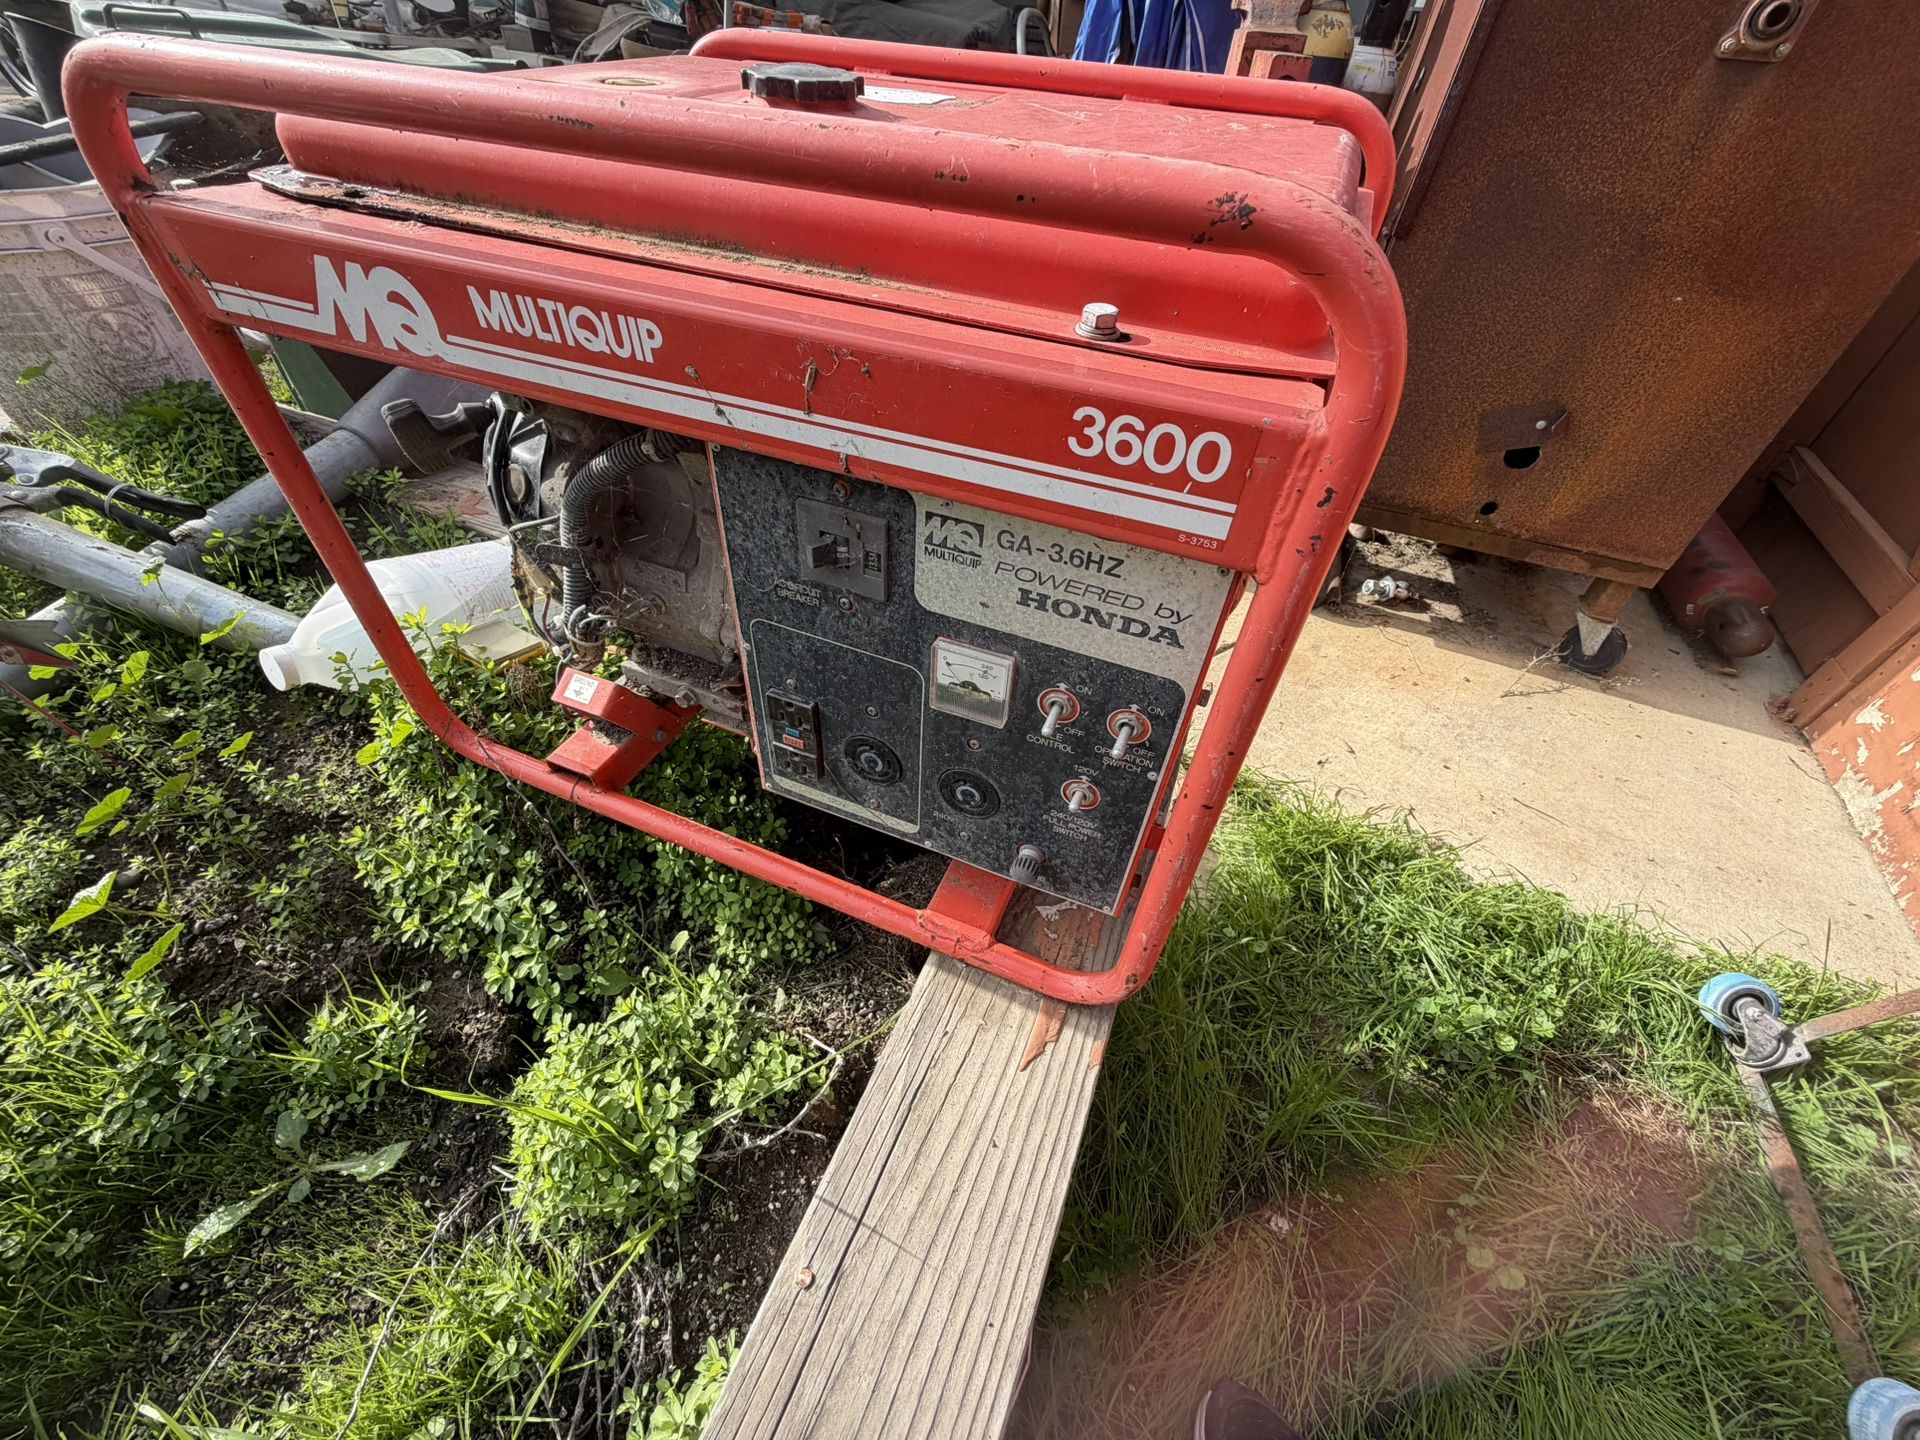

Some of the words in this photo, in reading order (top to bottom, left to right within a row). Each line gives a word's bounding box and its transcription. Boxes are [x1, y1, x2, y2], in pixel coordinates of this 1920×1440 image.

[313, 254, 446, 358] MQ
[467, 285, 662, 363] MULTIQUIP
[1067, 406, 1232, 483] 3600
[1177, 533, 1217, 549] S-3753
[924, 546, 982, 569] MULTIQUIP
[996, 529, 1125, 579] GA-3.6HZ
[778, 588, 820, 608] BREAKER
[994, 562, 1145, 610] POWERED
[1154, 602, 1194, 625] by
[1016, 588, 1185, 649] HONDA
[1076, 685, 1093, 696] ON
[1148, 706, 1165, 717] ON
[1064, 727, 1086, 737] OFF
[1026, 734, 1076, 754] CONTROL
[1133, 747, 1155, 758] OFF
[1073, 765, 1099, 776] 120V
[1102, 757, 1141, 774] SWITCH
[1042, 815, 1067, 828] FULL
[1068, 823, 1103, 839] POWER
[1050, 809, 1098, 829] 240/120V
[1052, 825, 1088, 841] SWITCH
